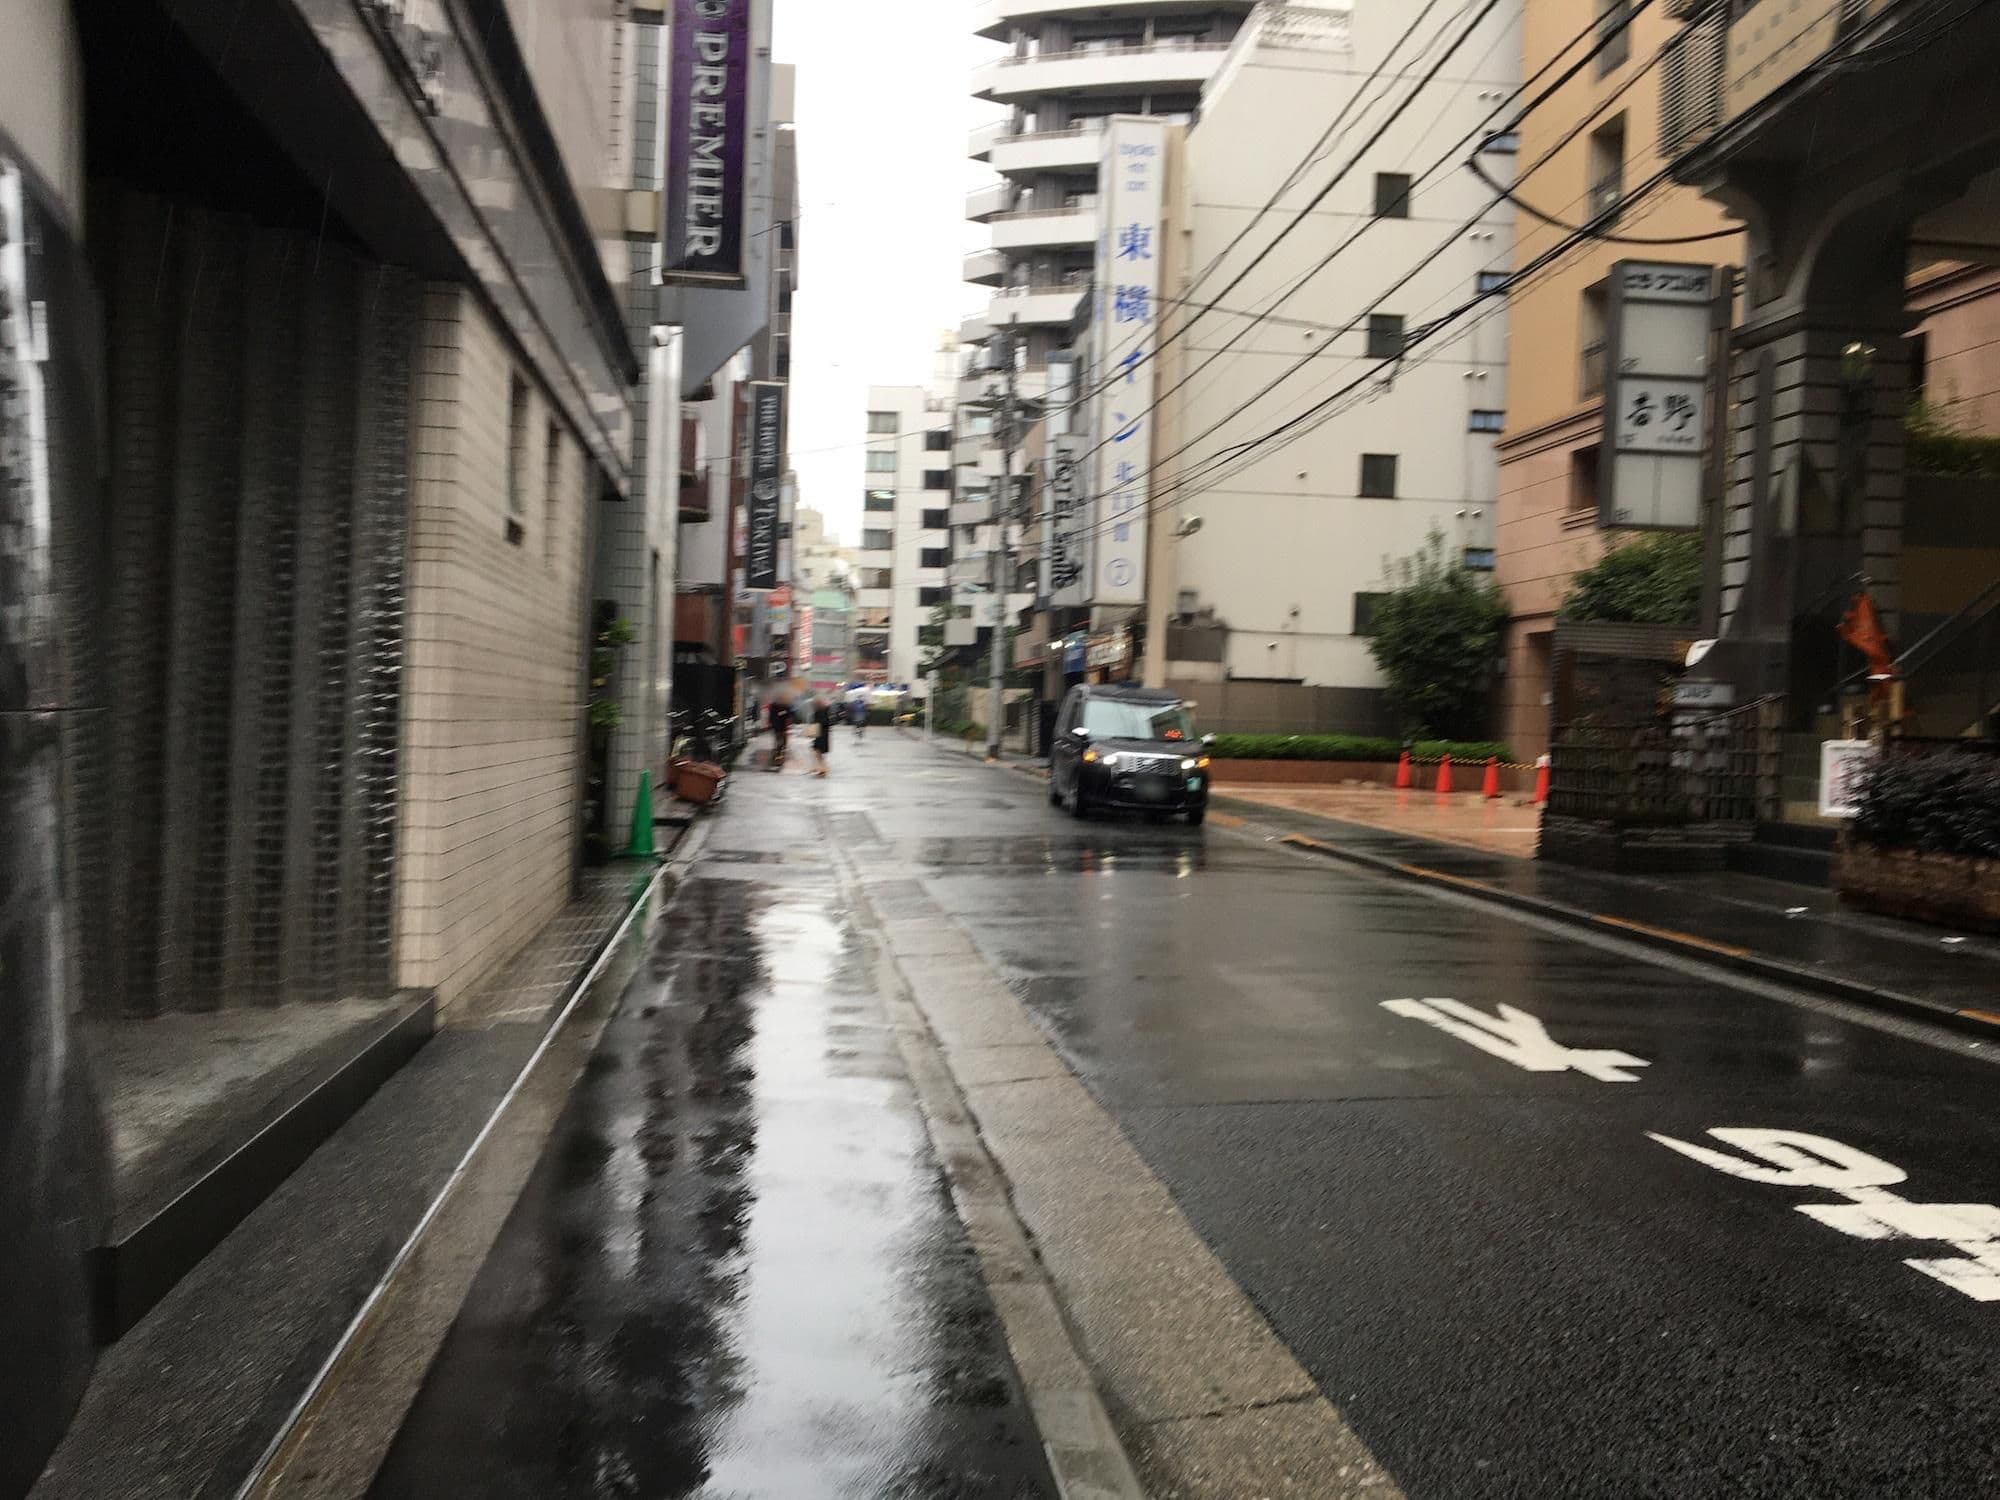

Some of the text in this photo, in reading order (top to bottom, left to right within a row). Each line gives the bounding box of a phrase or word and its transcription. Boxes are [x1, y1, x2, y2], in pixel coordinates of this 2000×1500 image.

[684, 31, 729, 258] PREMIER
[1113, 222, 1154, 443] 東横イン
[758, 426, 777, 472] HOTEL
